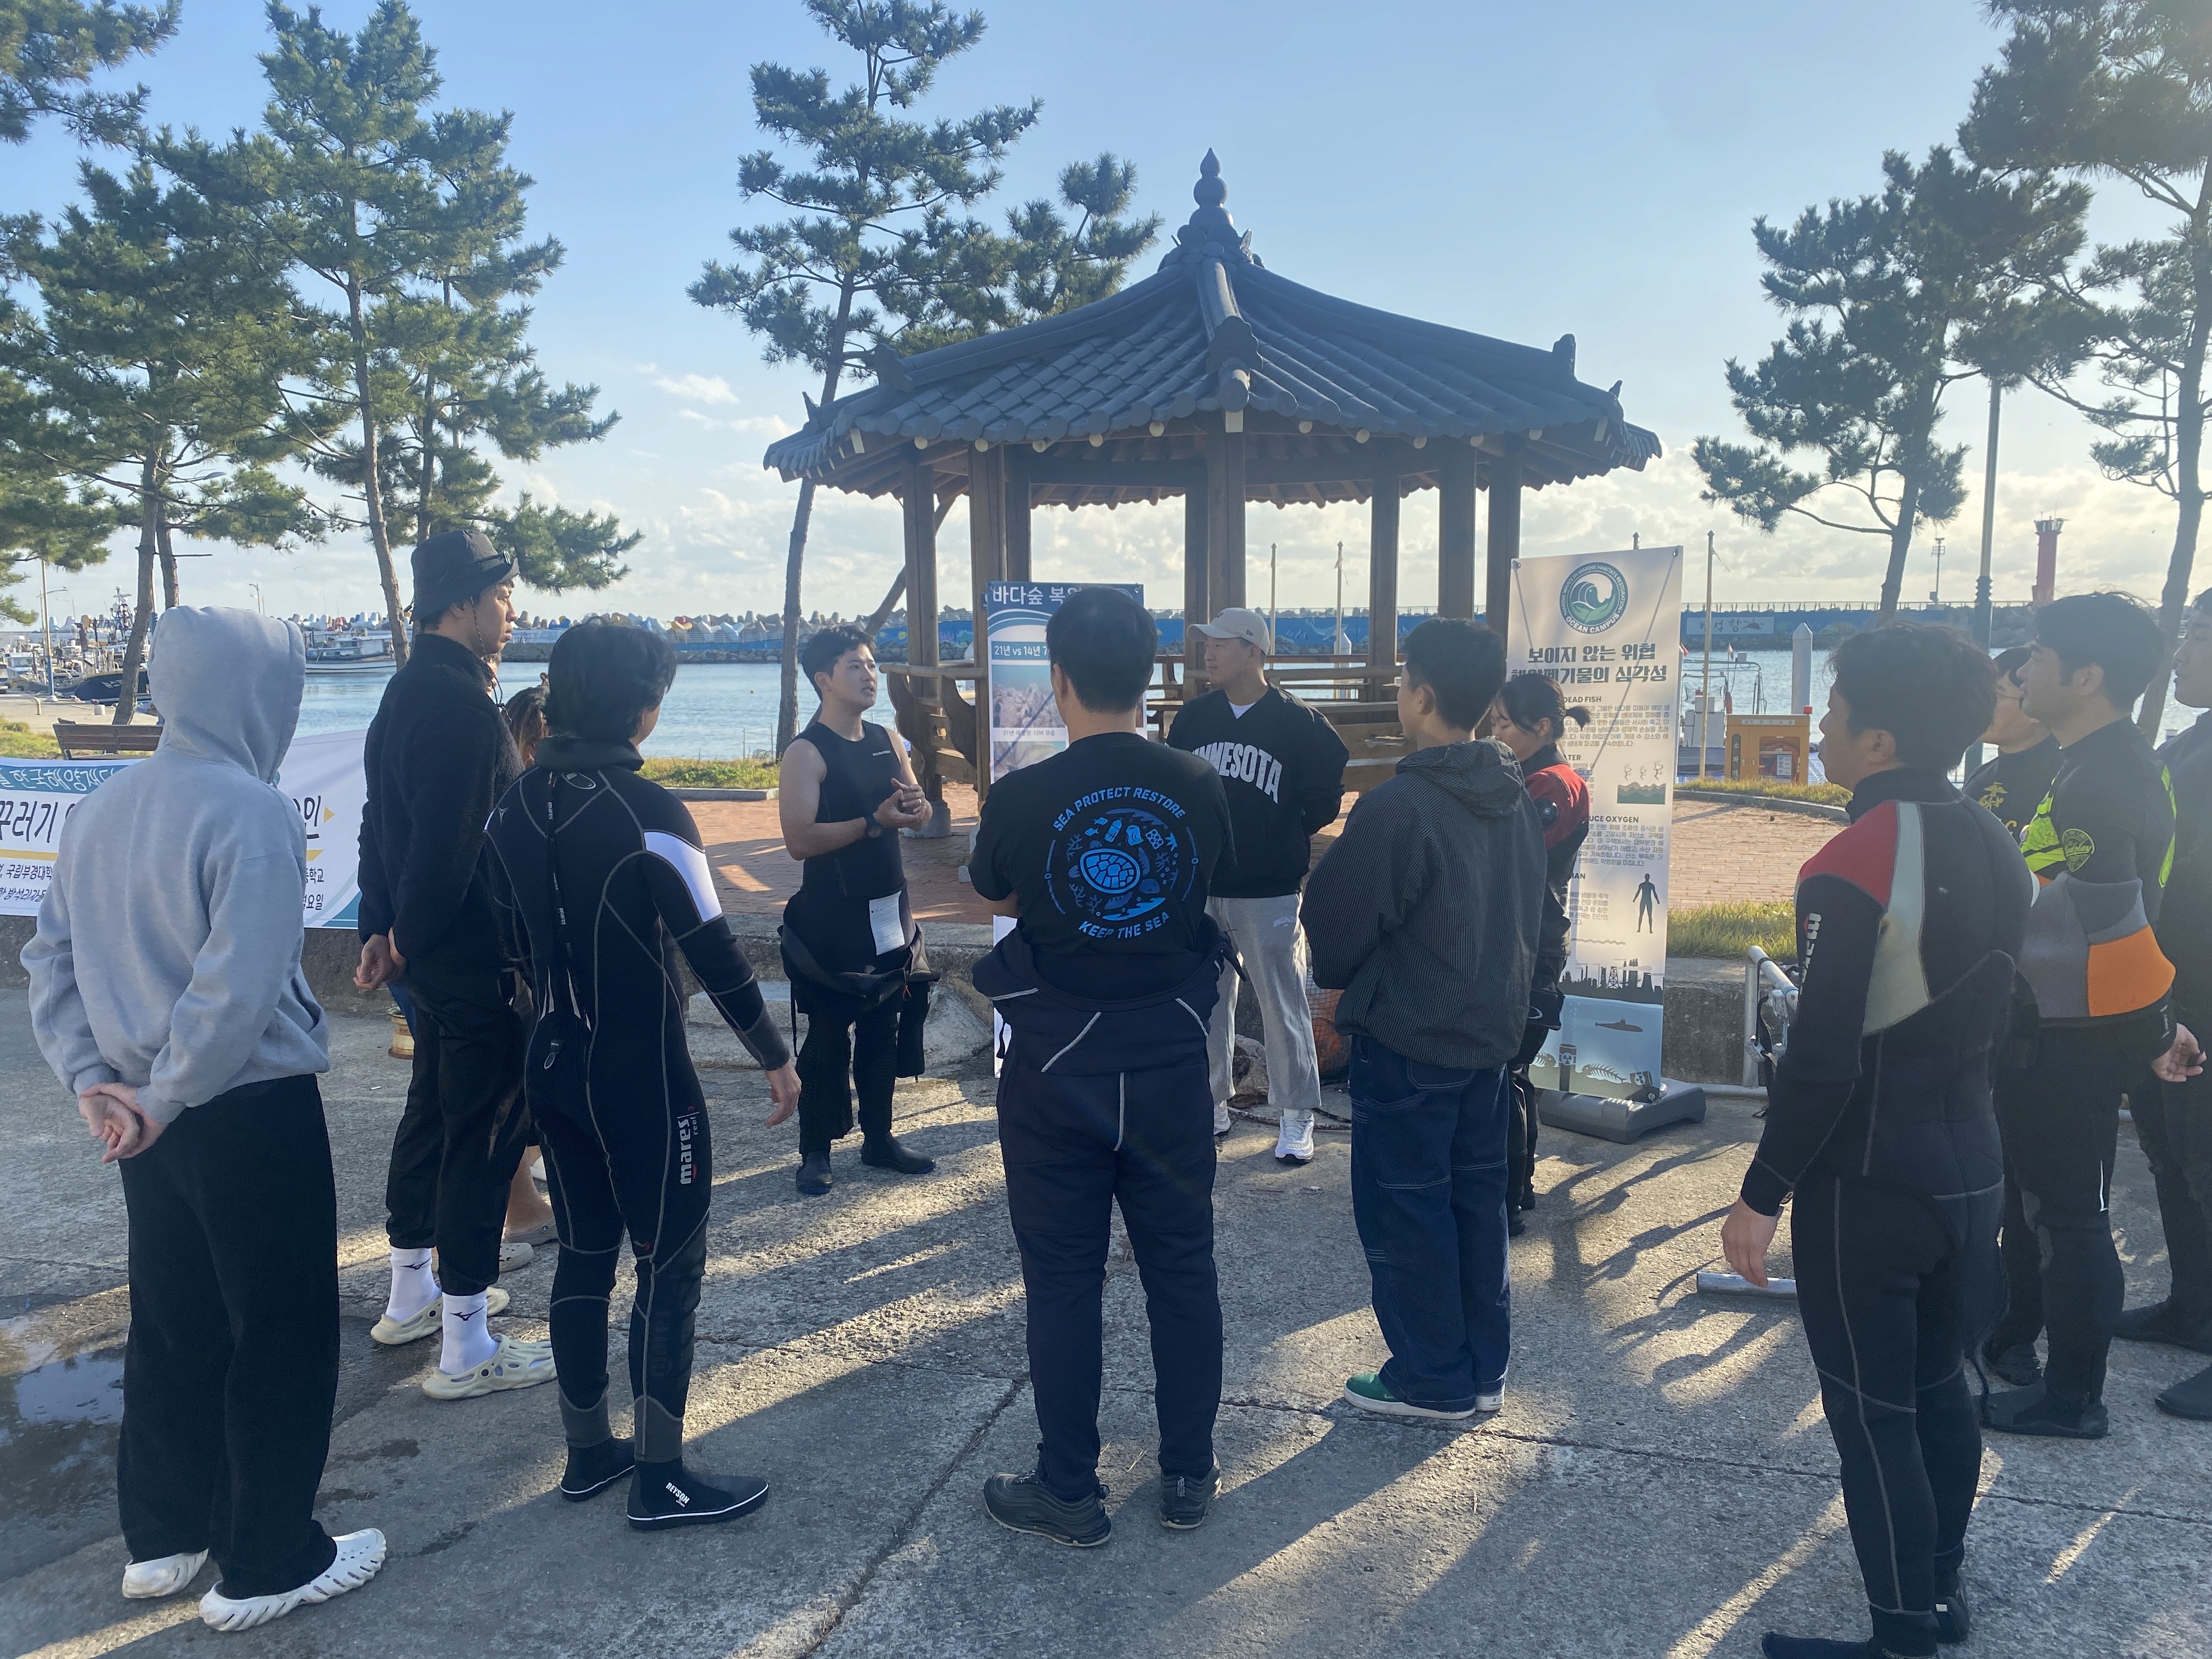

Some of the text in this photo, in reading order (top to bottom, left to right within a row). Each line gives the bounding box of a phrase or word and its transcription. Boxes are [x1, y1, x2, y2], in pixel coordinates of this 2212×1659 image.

[992, 586, 1043, 605] 바다숲
[1049, 586, 1082, 604] 복
[1563, 578, 1573, 595] WAVES
[1578, 565, 1596, 574] MARINE
[1597, 565, 1618, 578] HABITATS
[1616, 577, 1626, 611] RESTORATION
[1566, 613, 1620, 634] OCEAN CAMPUS
[994, 645, 1011, 657] 21년
[1024, 645, 1040, 657] 14년
[1528, 643, 1656, 663] 보이지 않는 위협
[1616, 665, 1667, 682] 심각성
[1164, 742, 1283, 804] NESOTA
[1053, 786, 1186, 832] SEA PROTECT RESTORE
[1078, 911, 1170, 939] KEEP THE SEA
[690, 1116, 698, 1135] reef
[678, 1119, 692, 1184] mares
